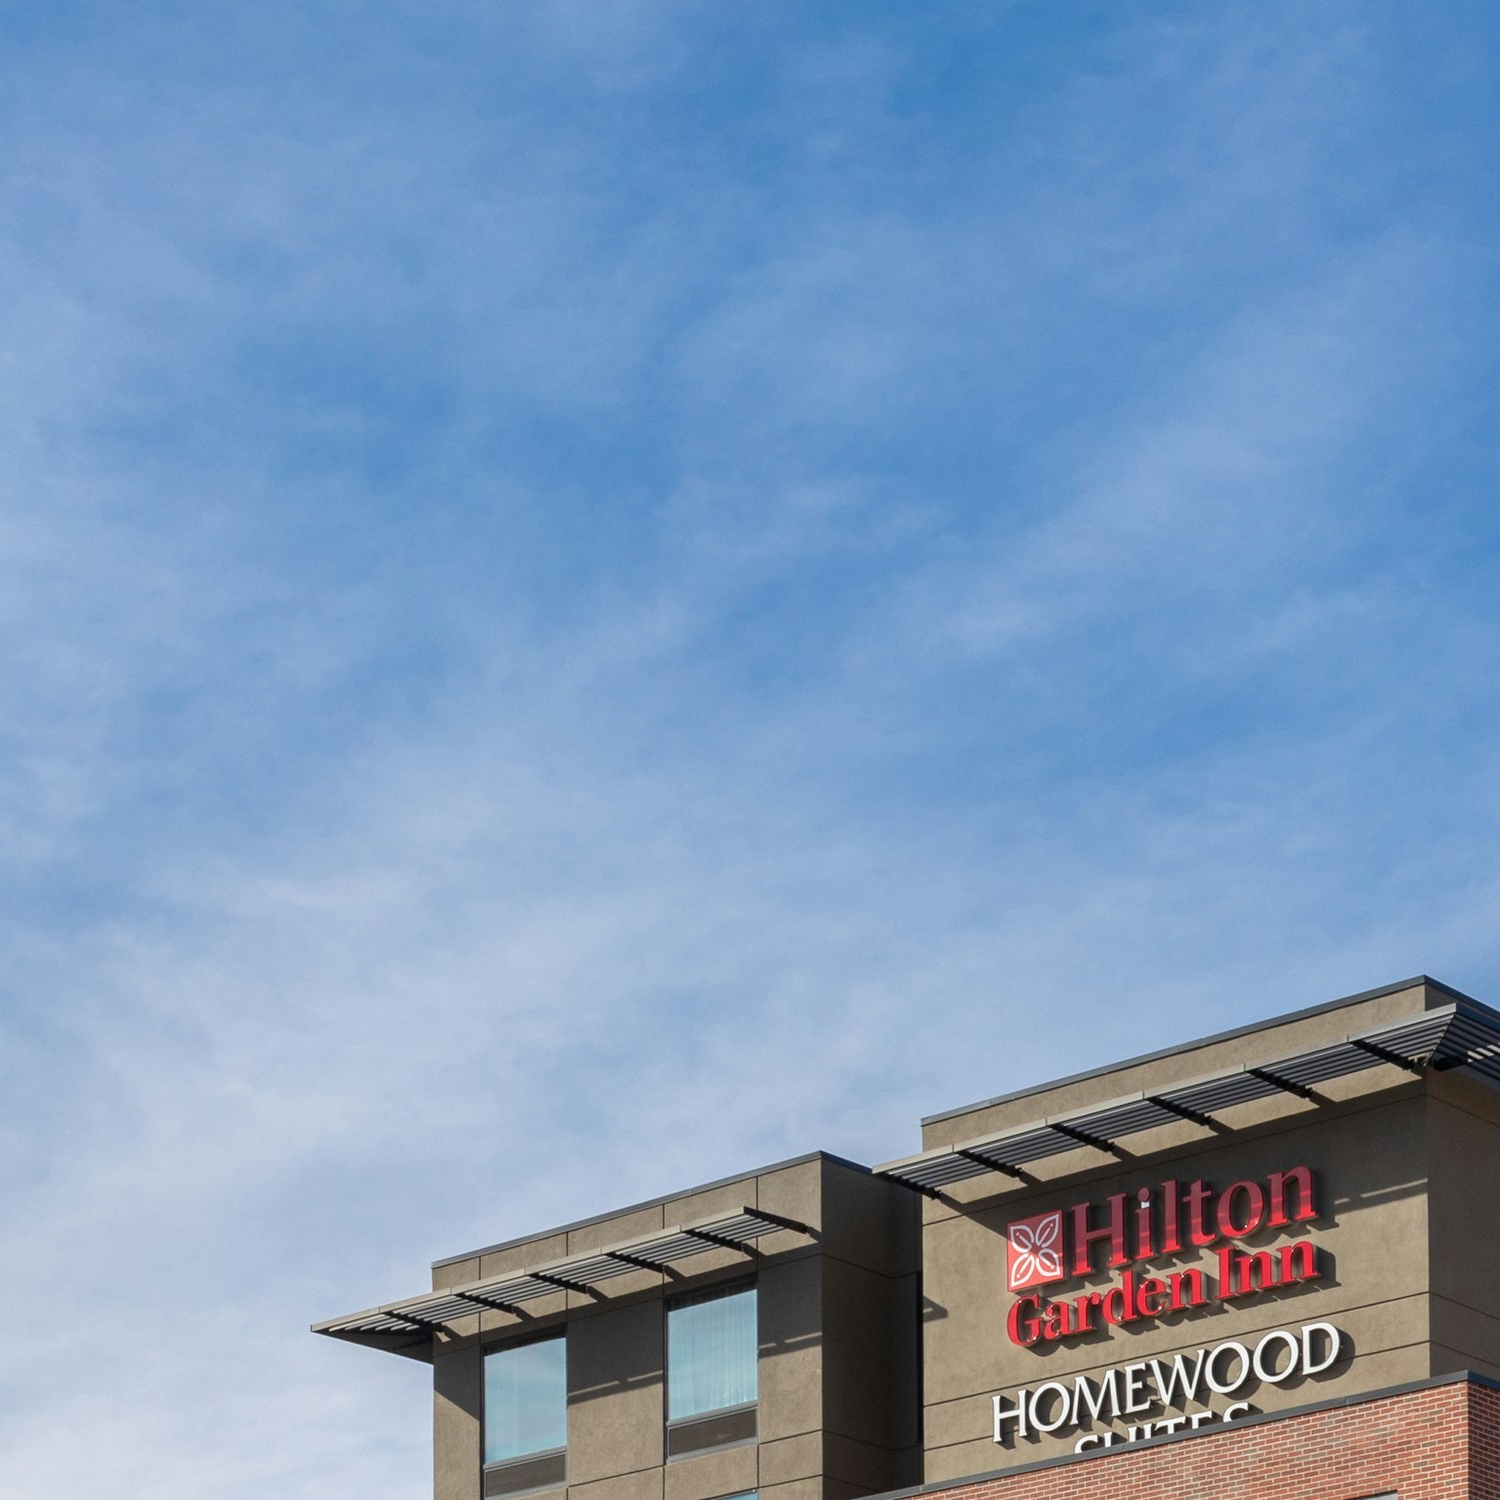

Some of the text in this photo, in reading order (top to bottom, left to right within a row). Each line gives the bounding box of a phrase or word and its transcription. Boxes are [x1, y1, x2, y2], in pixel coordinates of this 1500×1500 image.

[1072, 1165, 1317, 1277] Hilton
[1007, 1240, 1319, 1347] Garden Inn
[992, 1322, 1340, 1443] HOMEWOOD
